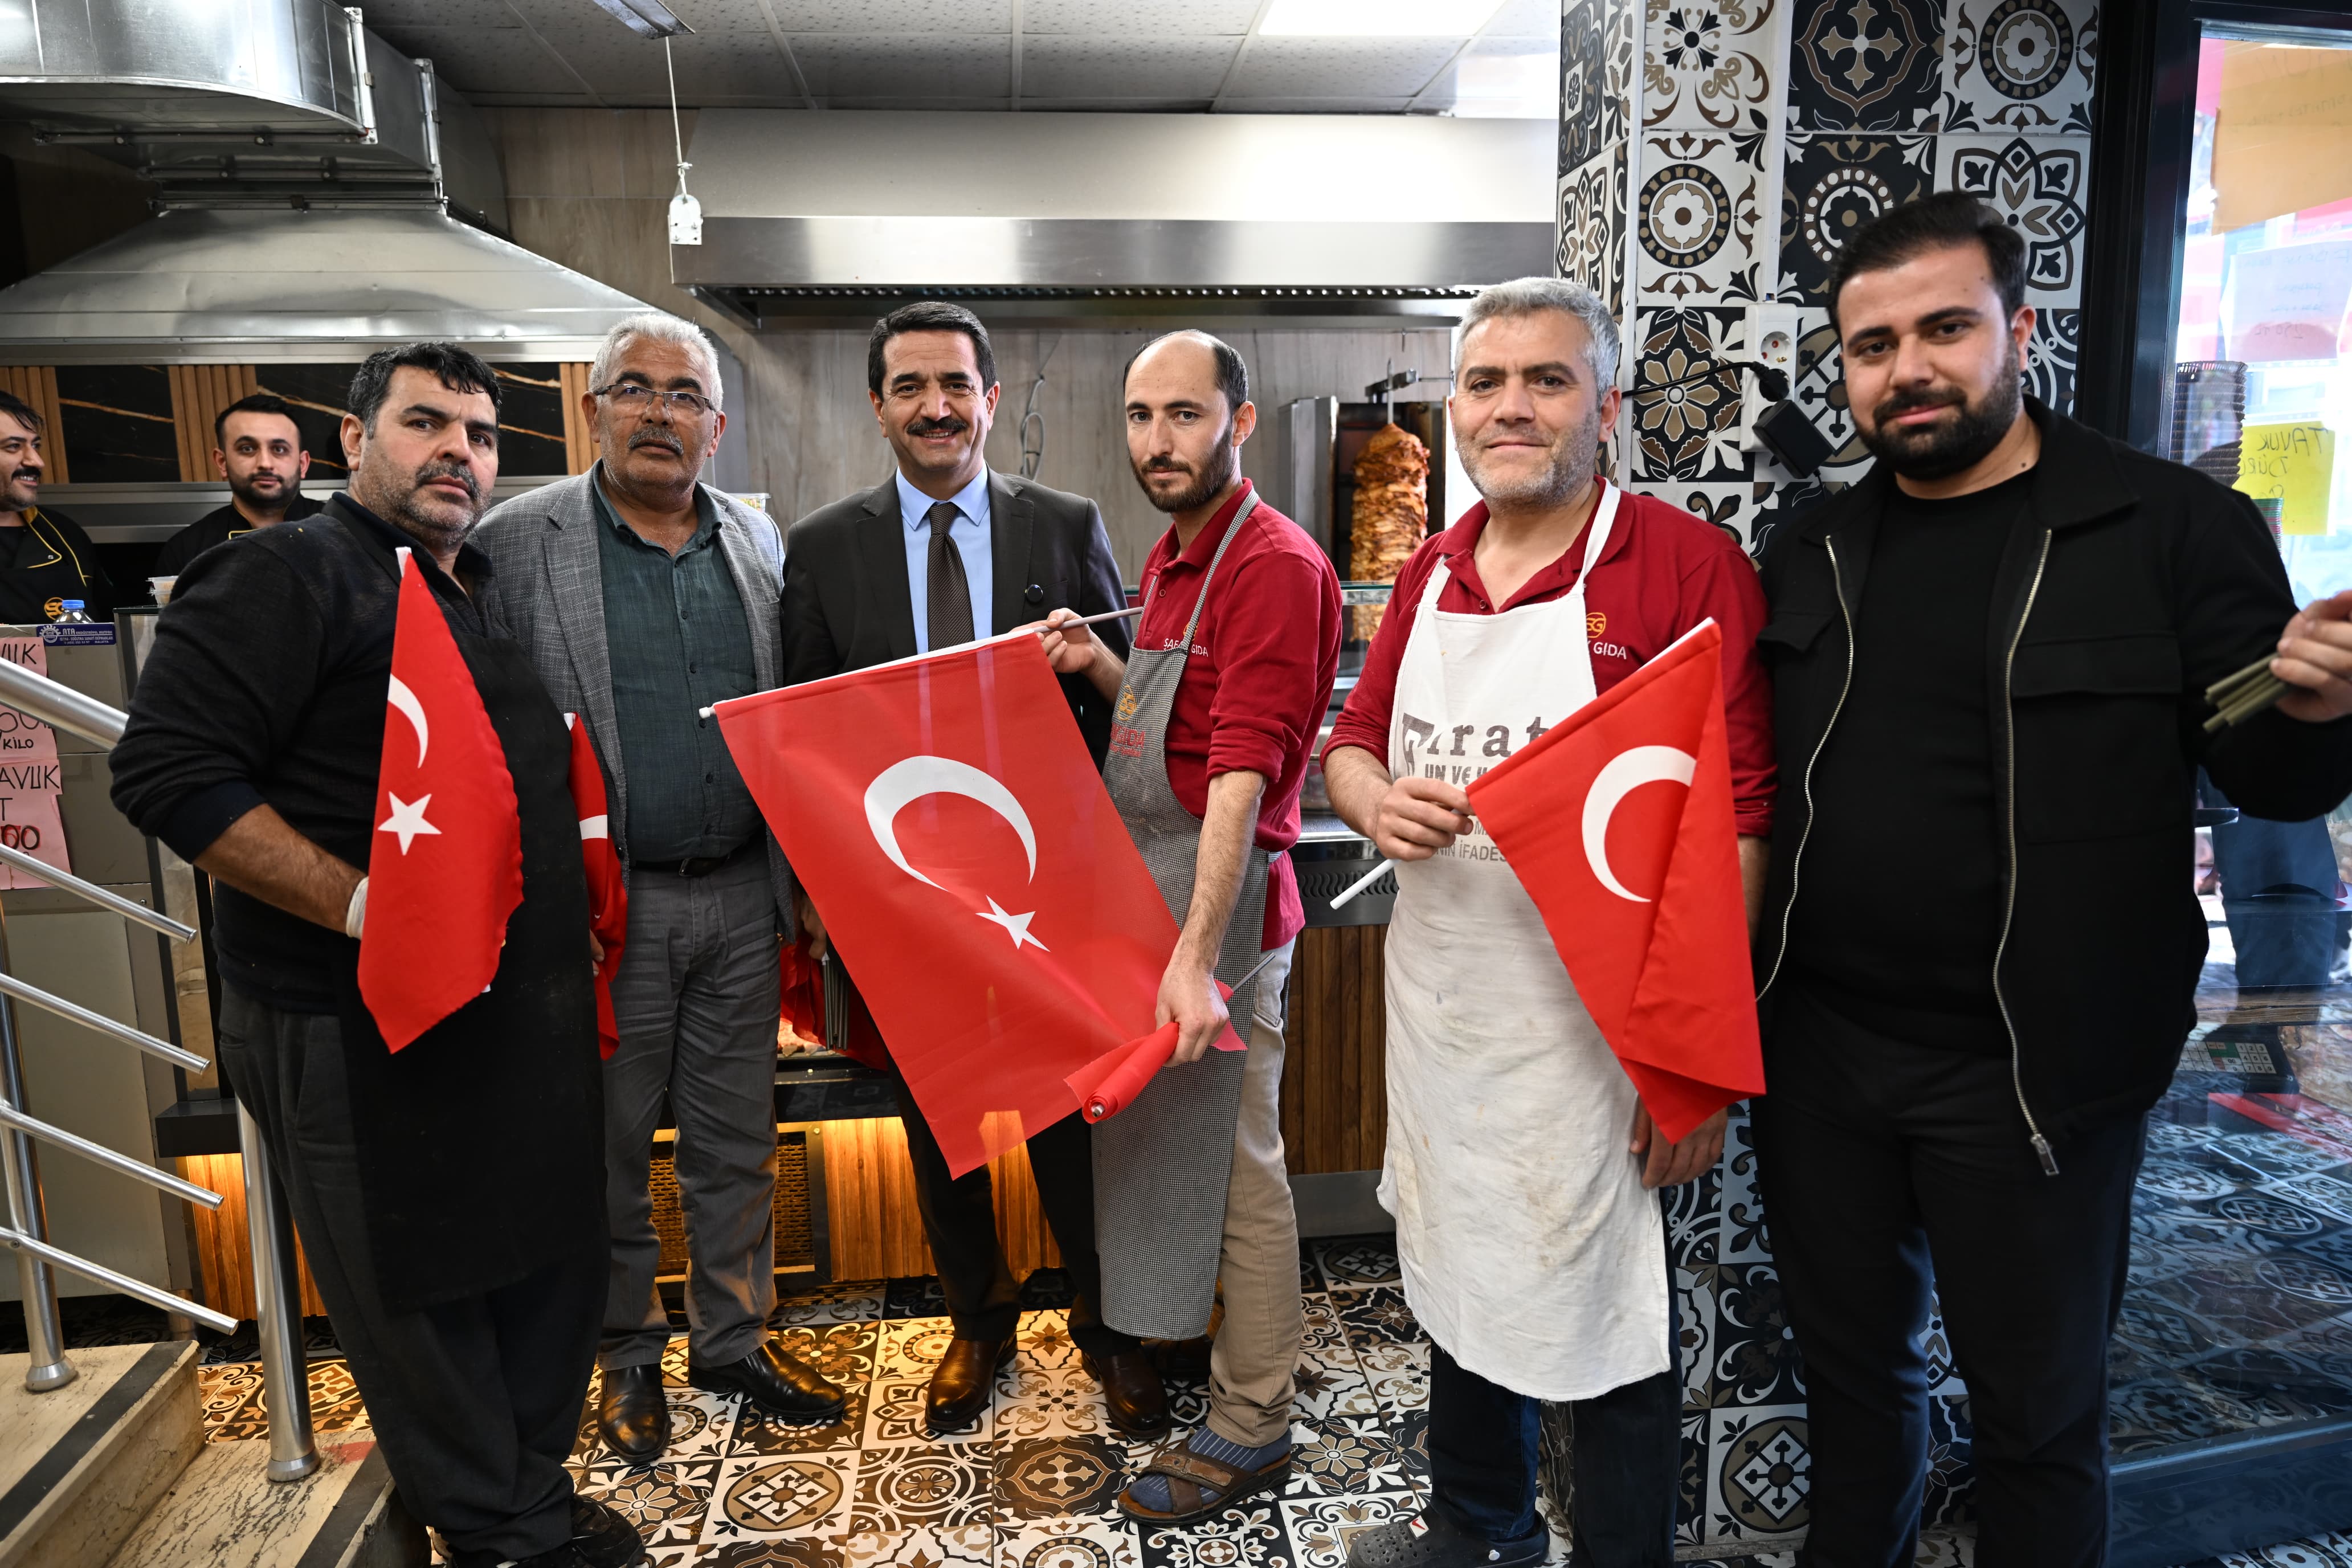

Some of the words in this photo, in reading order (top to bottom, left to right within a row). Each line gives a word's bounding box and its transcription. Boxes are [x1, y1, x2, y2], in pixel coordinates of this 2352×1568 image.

[1191, 644, 1208, 658] GIDA
[1593, 642, 1627, 660] GIDA
[1426, 763, 1446, 782] UN
[1452, 765, 1472, 785] VE
